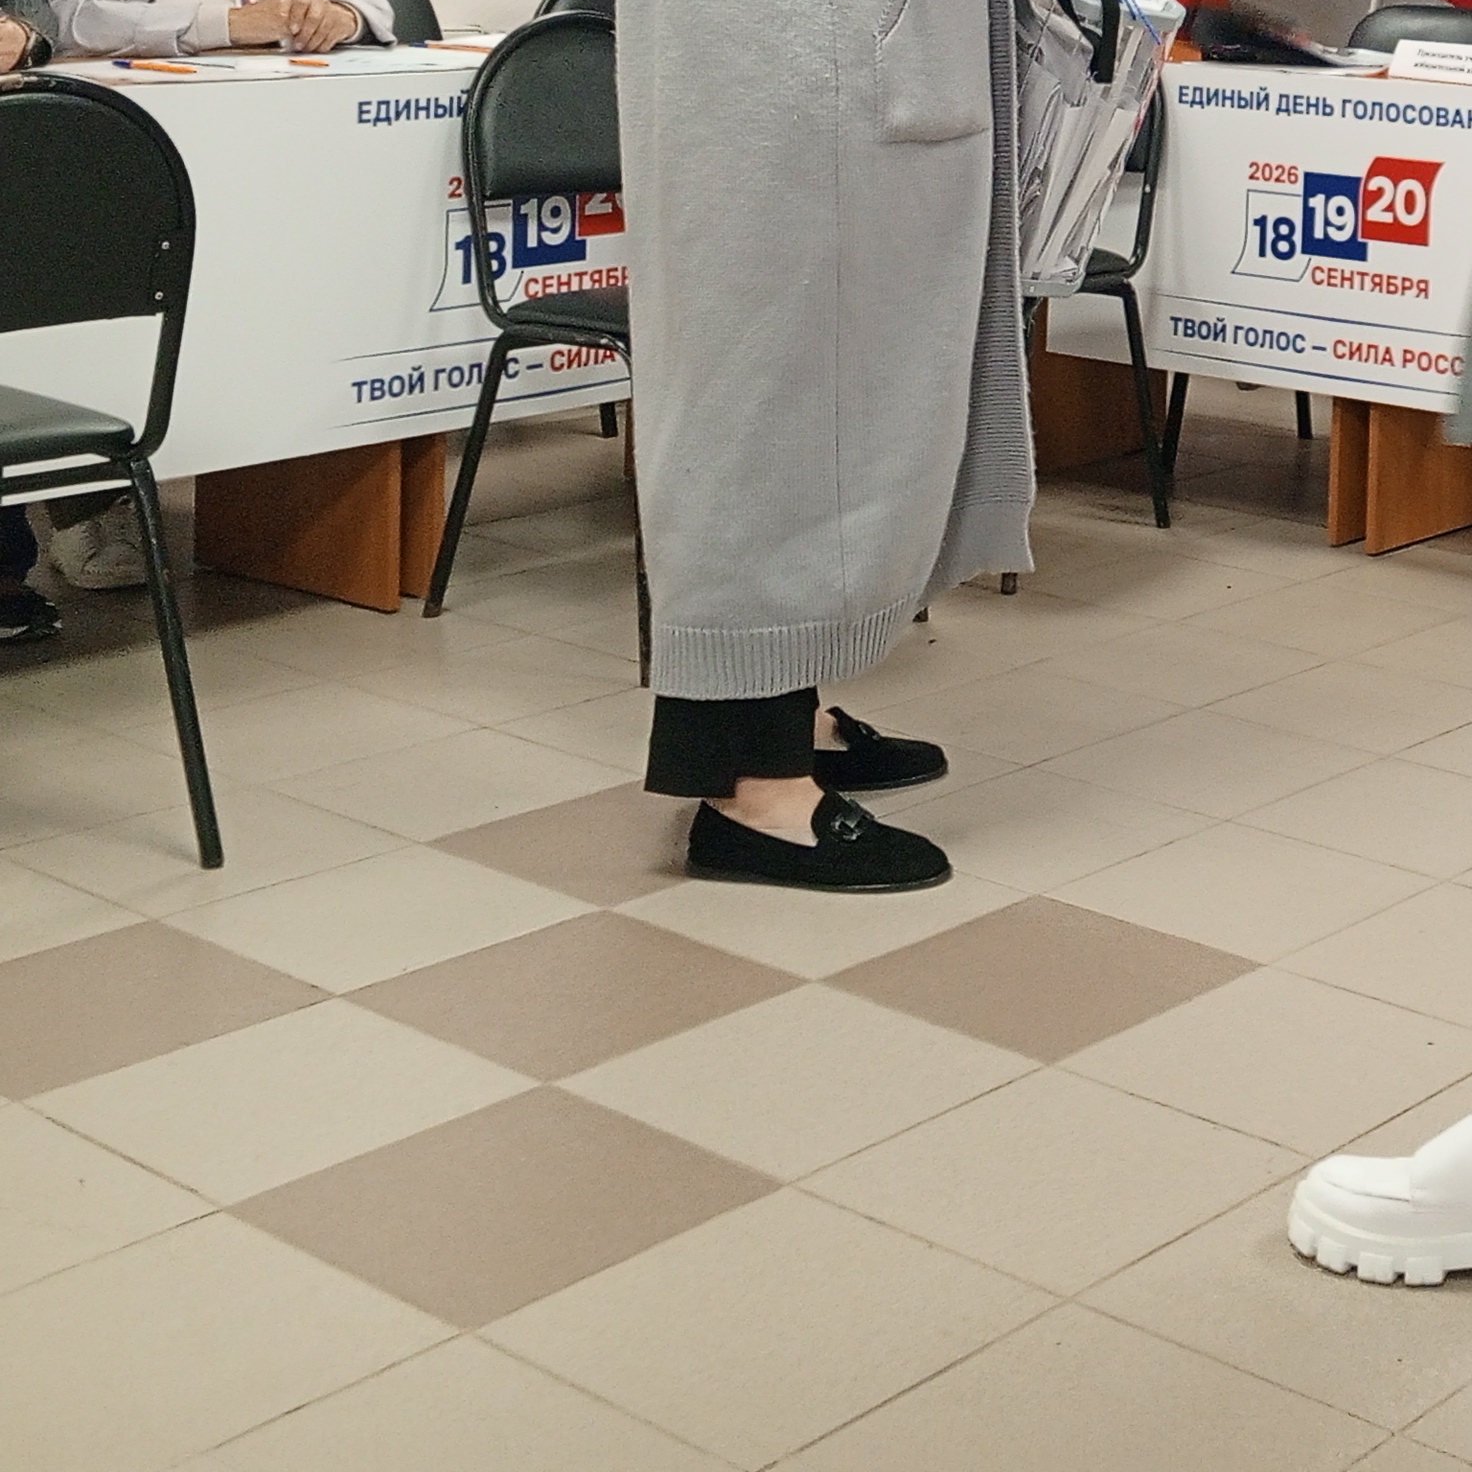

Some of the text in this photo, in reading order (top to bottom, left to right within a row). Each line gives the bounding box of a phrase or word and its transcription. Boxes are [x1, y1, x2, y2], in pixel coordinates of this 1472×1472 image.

[1178, 85, 1270, 113] ЕДИНЫЙ
[1276, 93, 1334, 118] ДЕНЬ
[1248, 162, 1299, 185] 2026
[520, 195, 572, 248] 19
[1253, 175, 1427, 261] 18 19 20
[1311, 265, 1430, 299] СЕНТЯБРЯ
[1170, 316, 1227, 344] ТВОЙ
[1232, 325, 1306, 354] ГОЛОС
[1332, 339, 1396, 367] СИЛА
[352, 366, 425, 403] ТВОЙ
[433, 357, 520, 392] ГОЛС
[550, 347, 618, 373] СИЛА
